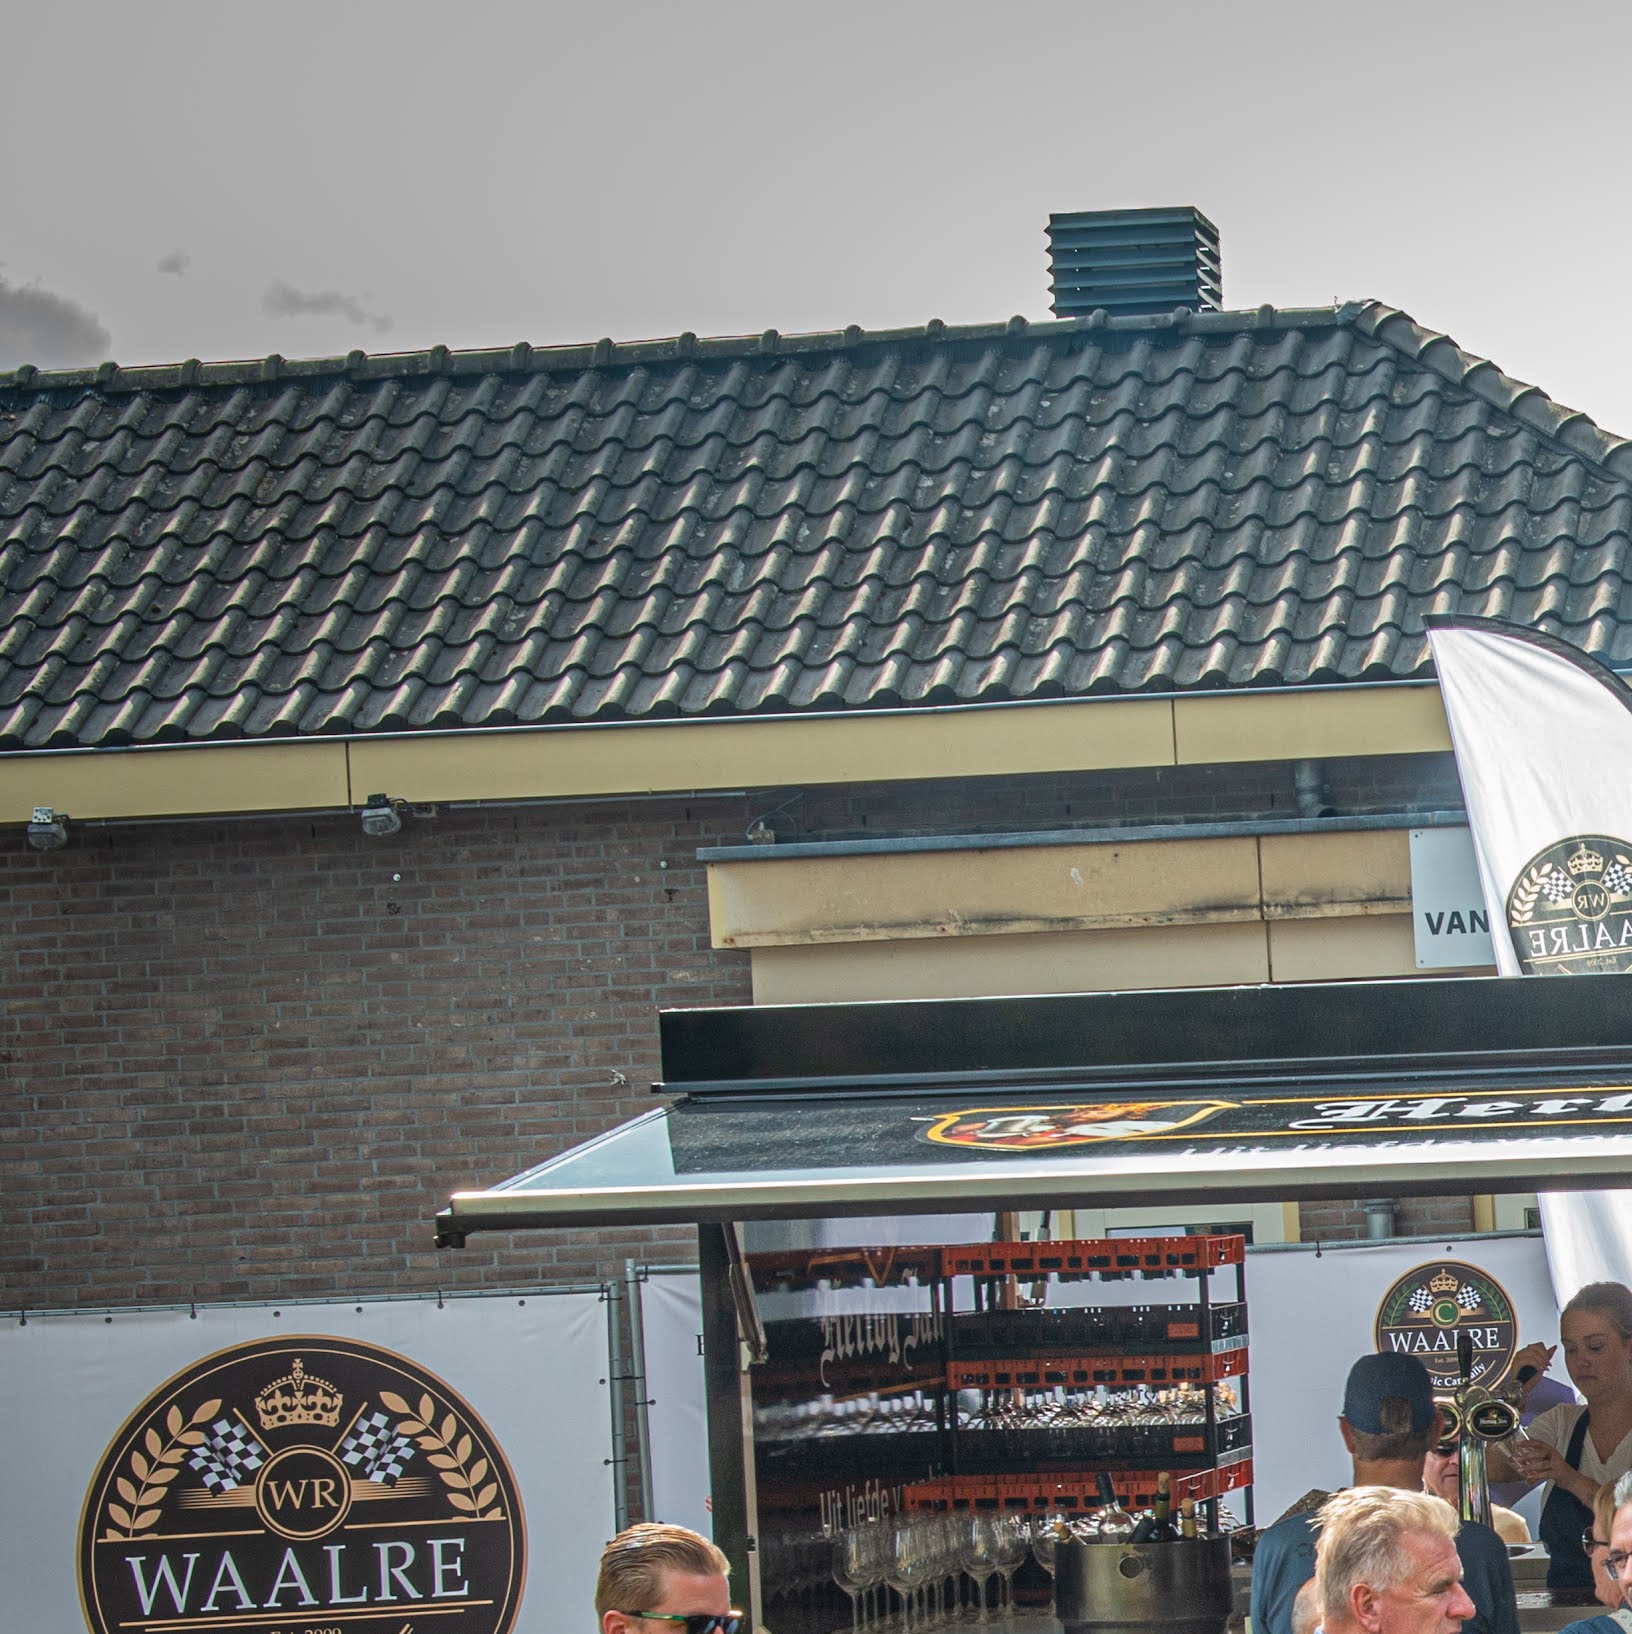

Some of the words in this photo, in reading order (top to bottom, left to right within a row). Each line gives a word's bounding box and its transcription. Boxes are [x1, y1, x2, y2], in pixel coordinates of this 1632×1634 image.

[1424, 909, 1490, 935] VAN
[1435, 1303, 1453, 1323] C
[266, 1478, 339, 1509] WR
[125, 1538, 469, 1616] WAALRE
